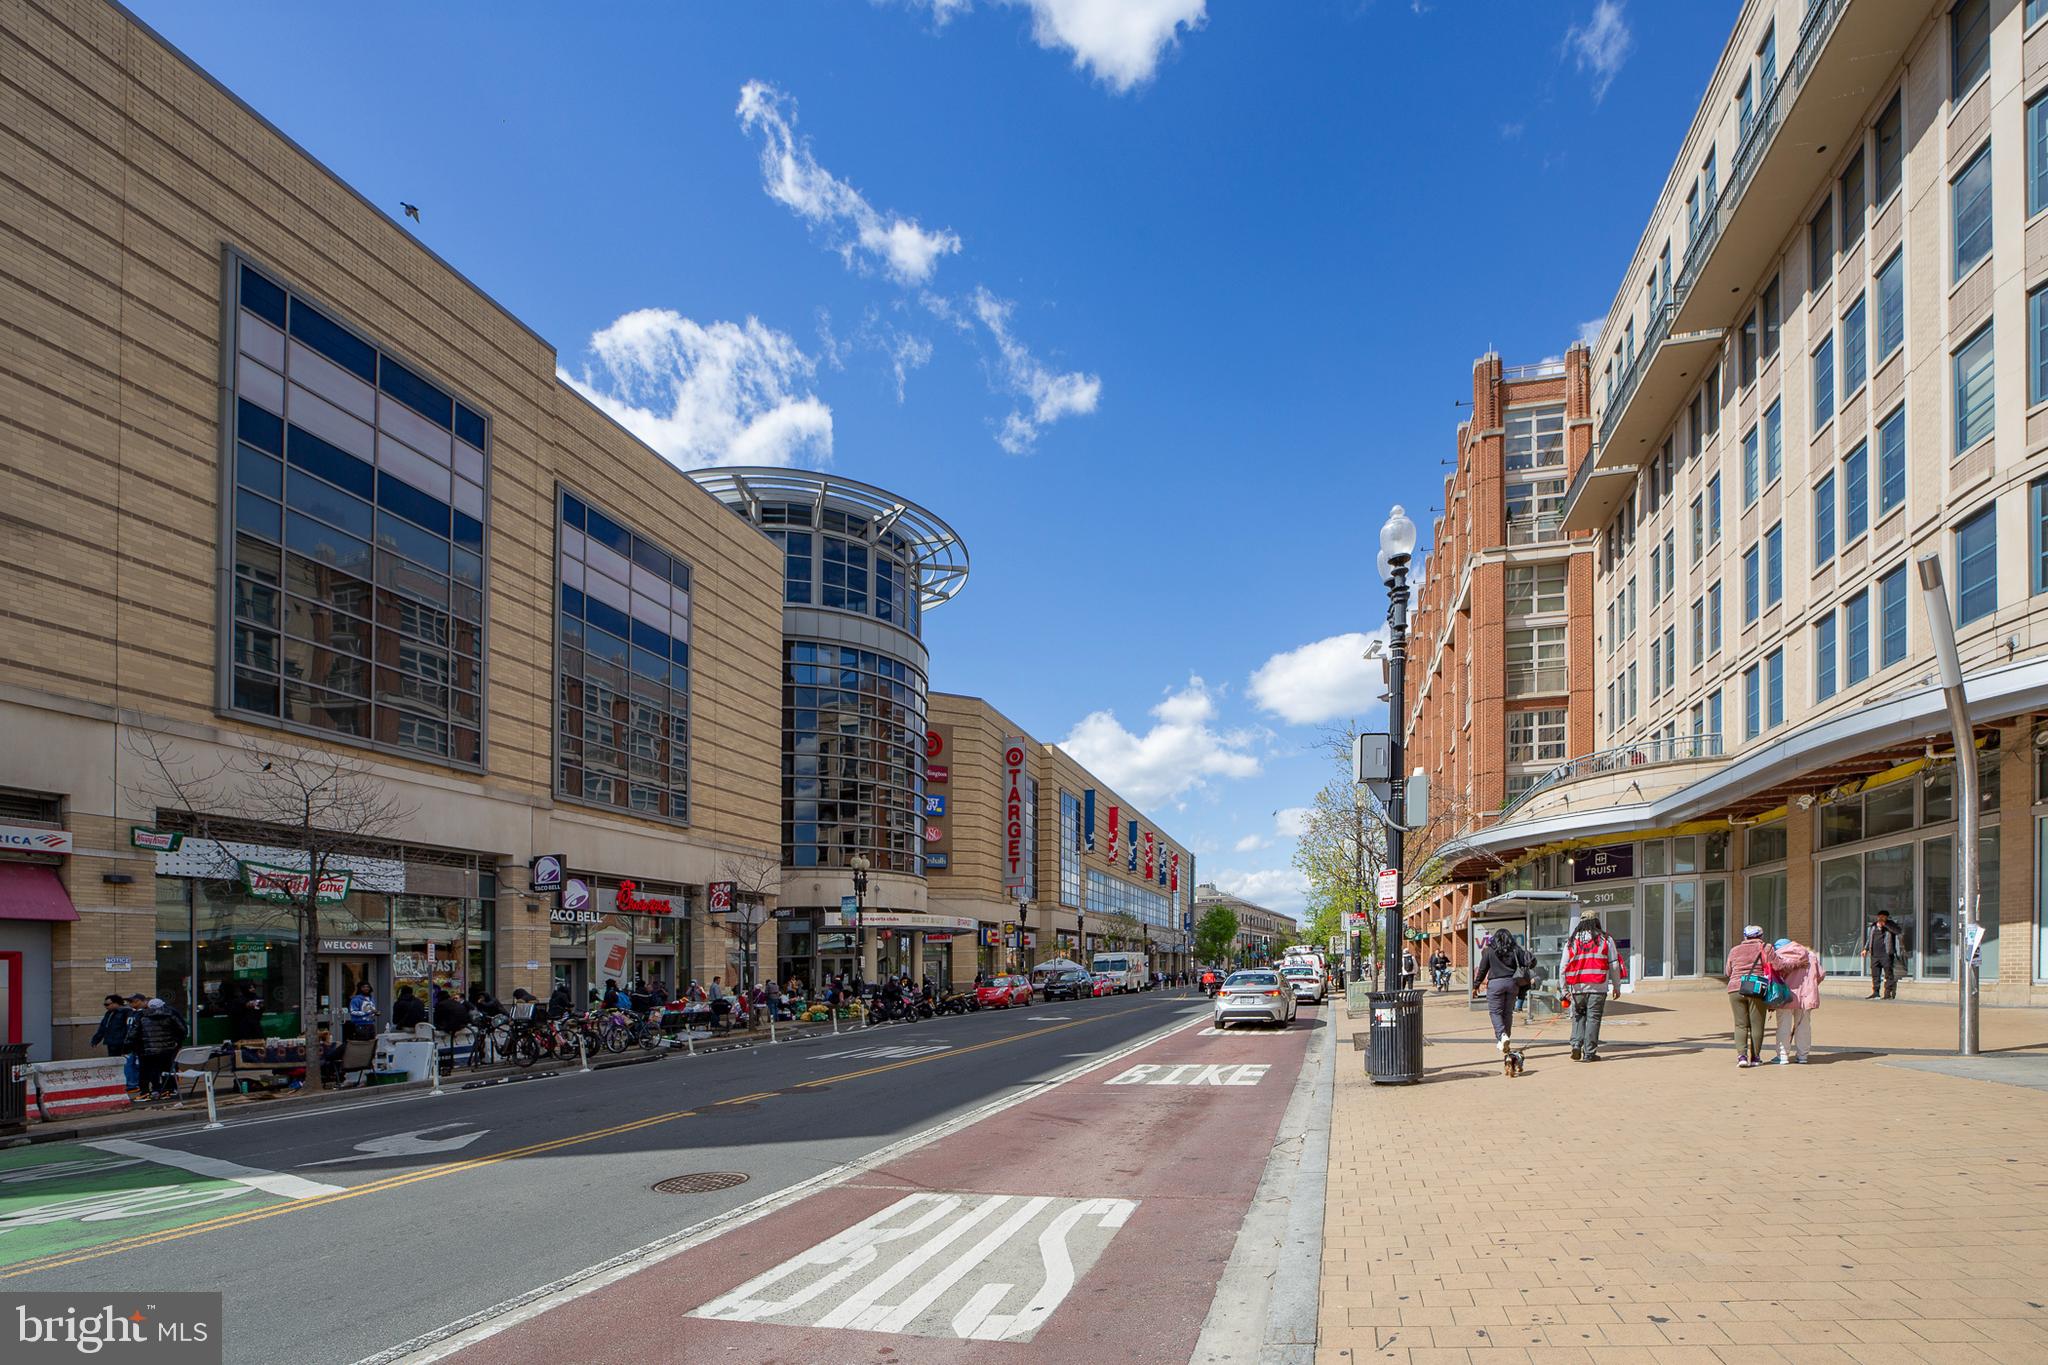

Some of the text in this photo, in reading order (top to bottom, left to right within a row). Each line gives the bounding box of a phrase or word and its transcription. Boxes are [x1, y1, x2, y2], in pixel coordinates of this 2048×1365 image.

[1007, 768, 1021, 874] TARGET
[0, 835, 31, 846] ICA
[1585, 865, 1617, 876] TRUIST
[1594, 893, 1614, 902] 3101
[577, 911, 603, 923] BELL
[324, 941, 374, 950] WELCOME
[1103, 1064, 1272, 1085] BIKE
[686, 1193, 1138, 1341] BUS
